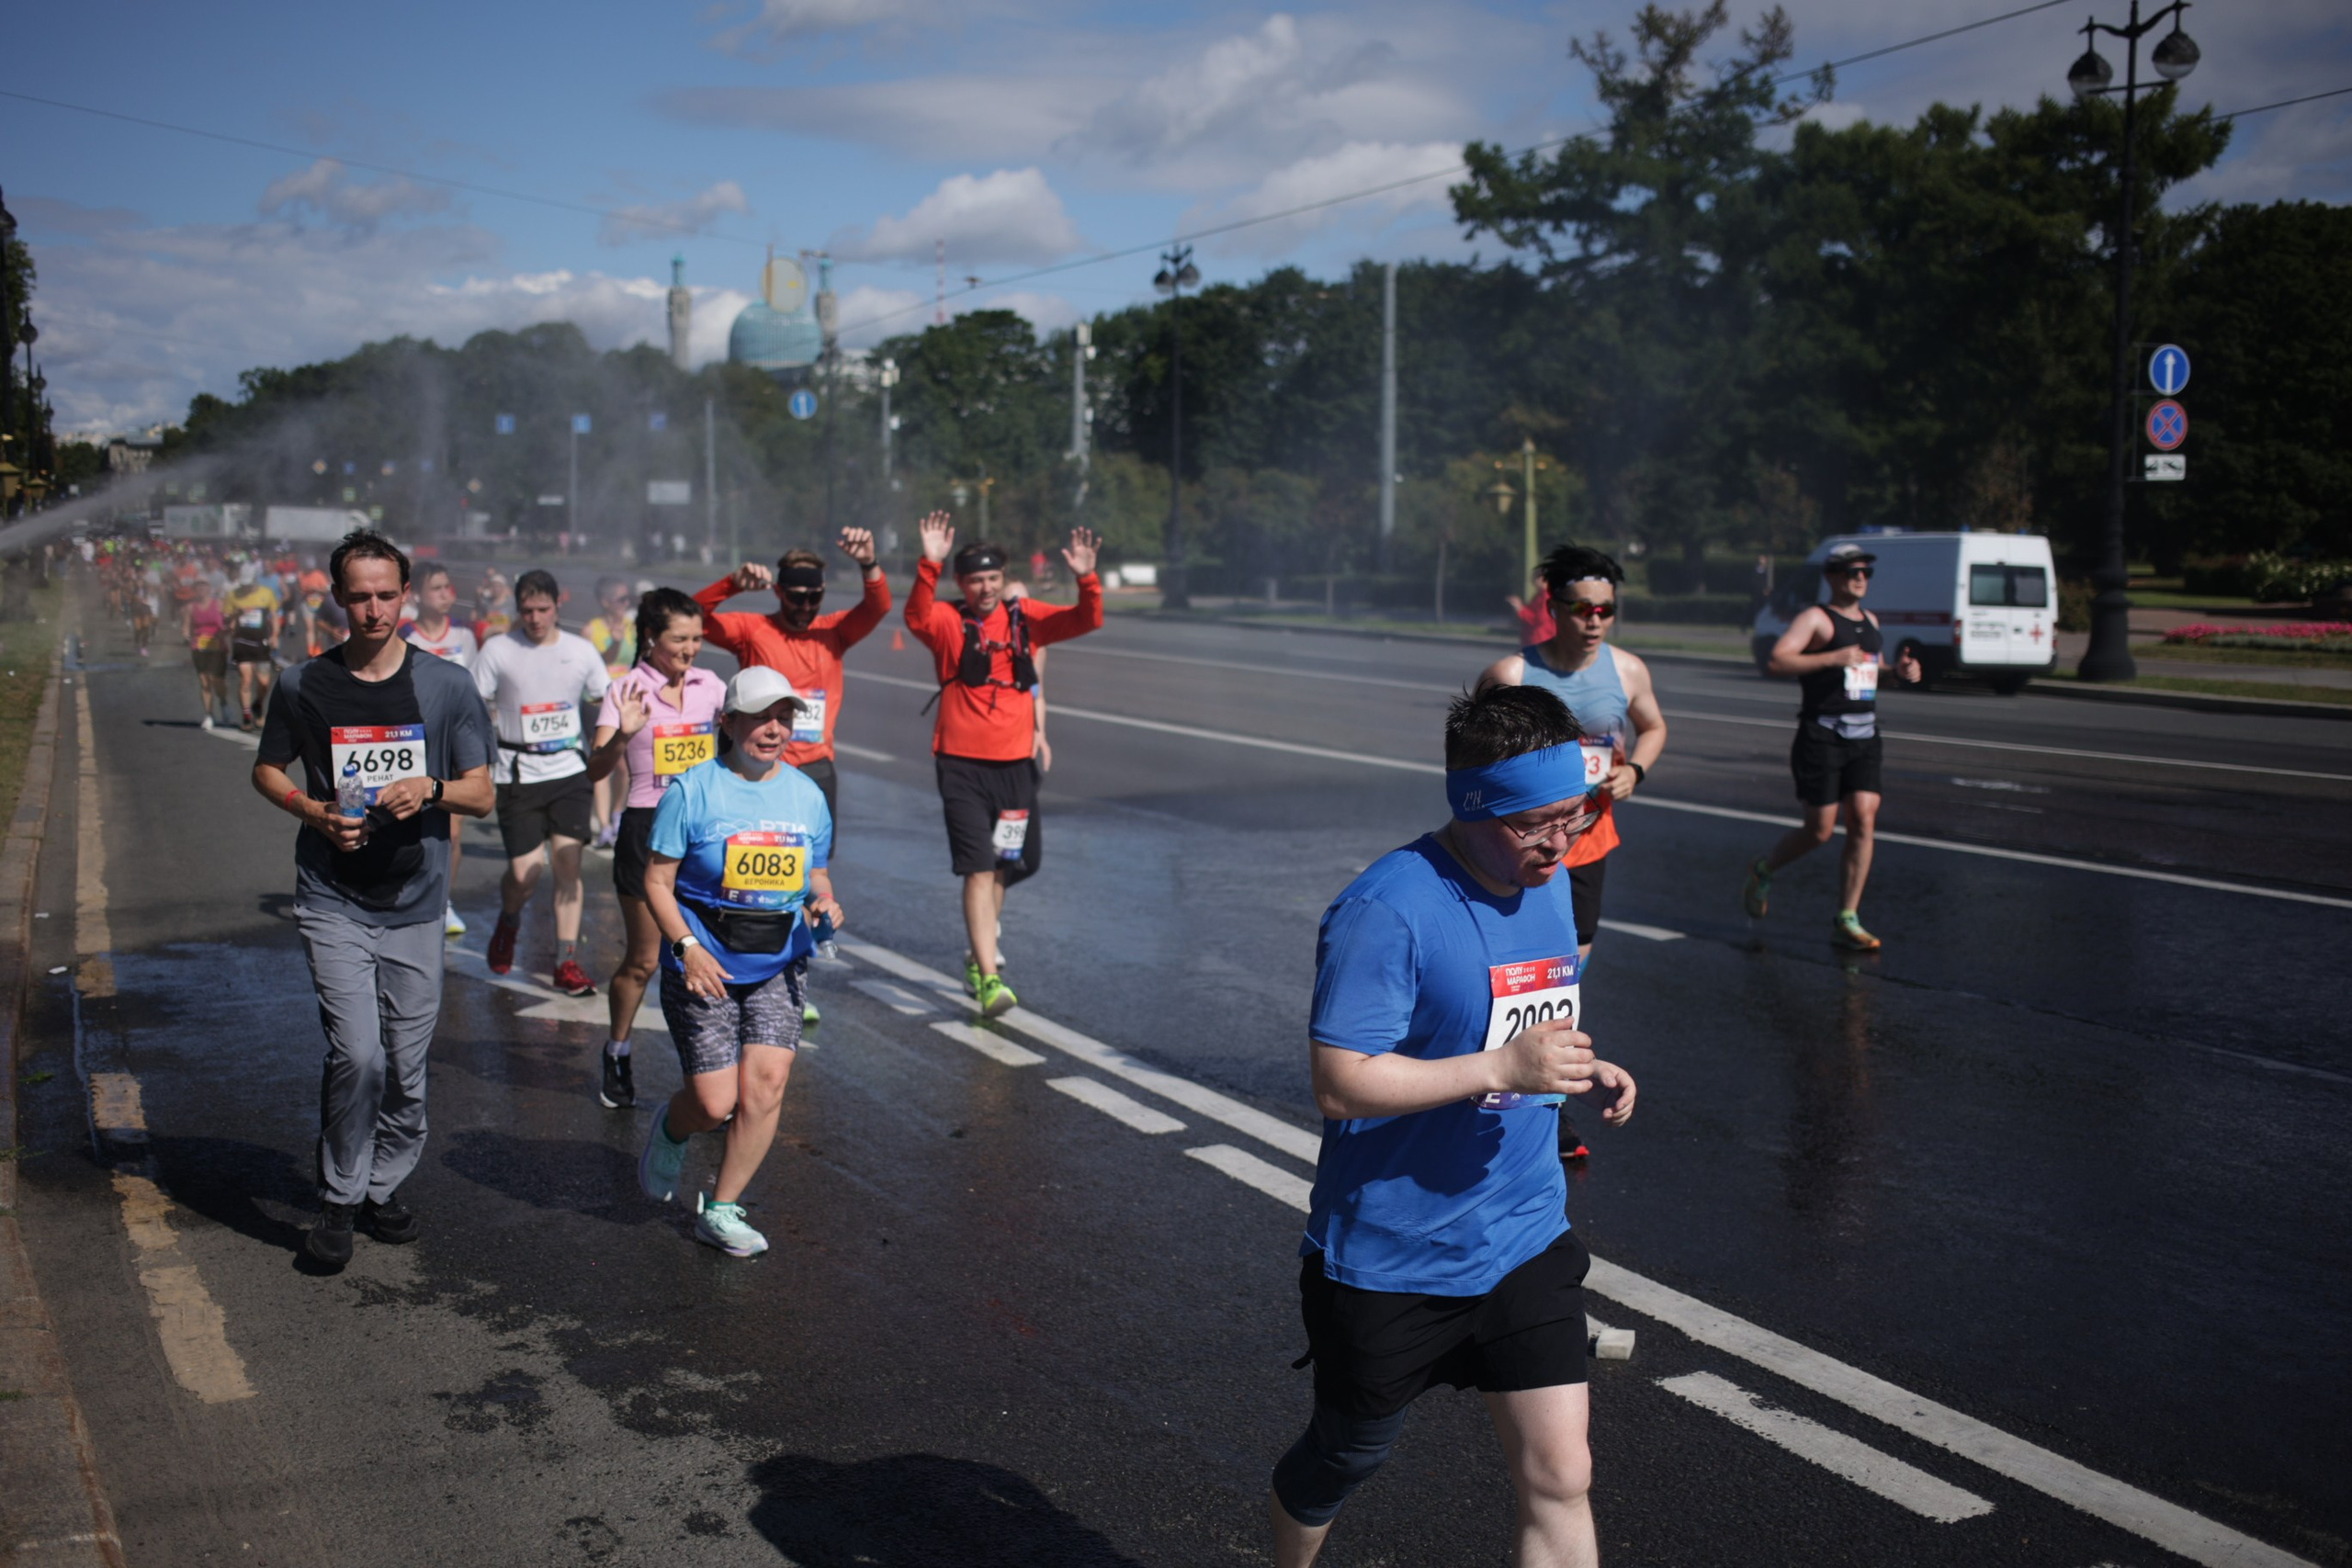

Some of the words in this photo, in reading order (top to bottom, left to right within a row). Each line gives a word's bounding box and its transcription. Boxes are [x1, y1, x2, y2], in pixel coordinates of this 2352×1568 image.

[530, 715, 569, 733] 6754
[385, 730, 398, 739] 21,1
[664, 740, 707, 762] 5236
[344, 749, 413, 773] 6698
[367, 774, 394, 783] РЕНАТ
[736, 852, 796, 876] 6083
[744, 877, 785, 886] ВЕРОНИКА
[1505, 966, 1523, 976] ПОЛУ
[1547, 967, 1561, 980] 21,1
[1507, 974, 1536, 986] МАРАФОН
